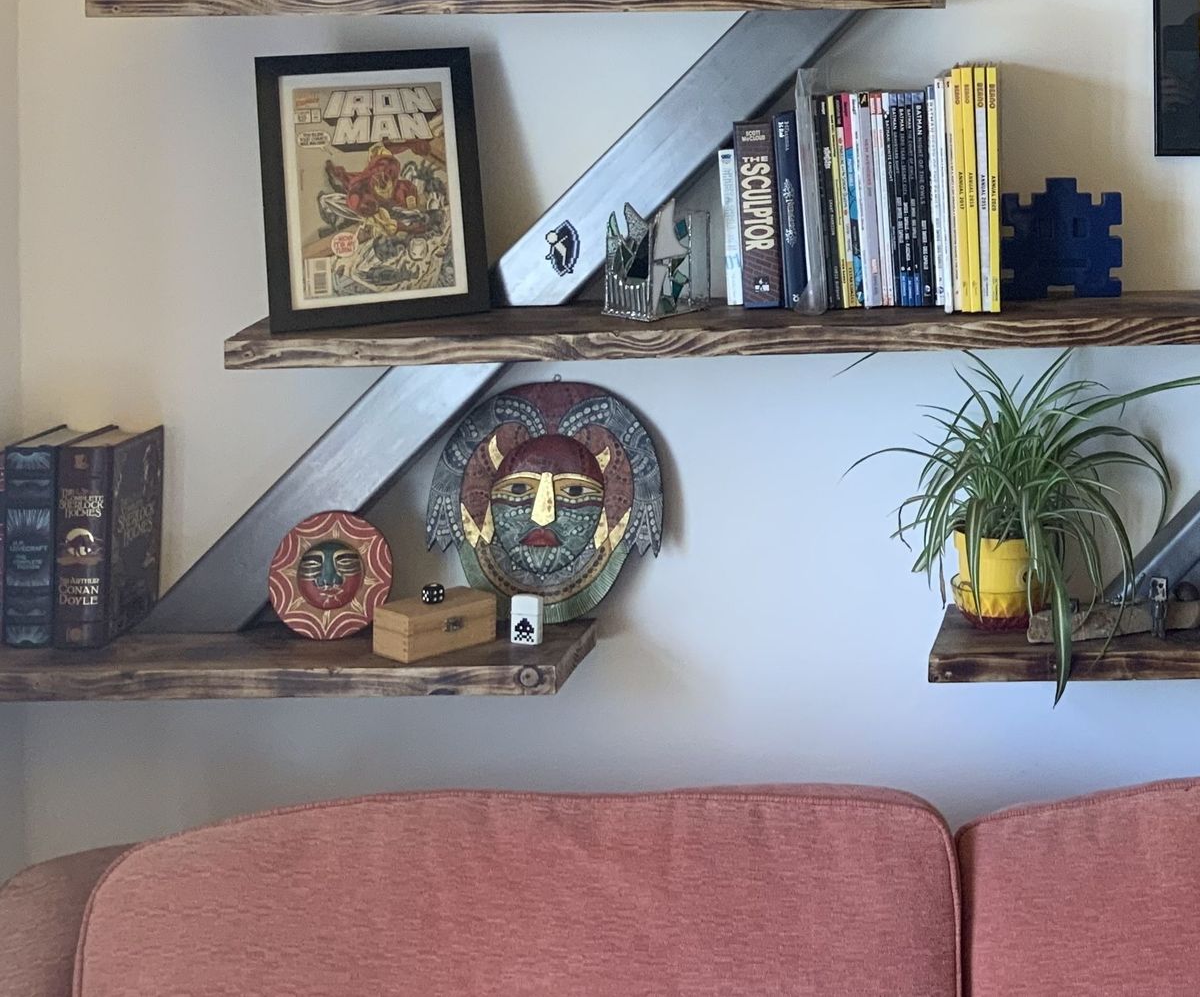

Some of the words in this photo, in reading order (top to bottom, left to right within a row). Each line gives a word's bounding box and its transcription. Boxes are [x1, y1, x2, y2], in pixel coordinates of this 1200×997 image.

[323, 86, 437, 119] IRON
[332, 113, 434, 146] MAN
[742, 155, 768, 163] THE
[917, 159, 923, 168] OF
[741, 162, 775, 252] SCULPTOR
[62, 495, 104, 503] COMPLETE
[59, 500, 104, 510] SHERLOCK
[65, 508, 101, 518] HOLMES
[59, 586, 99, 594] CONAN
[59, 596, 98, 606] DOYLE
